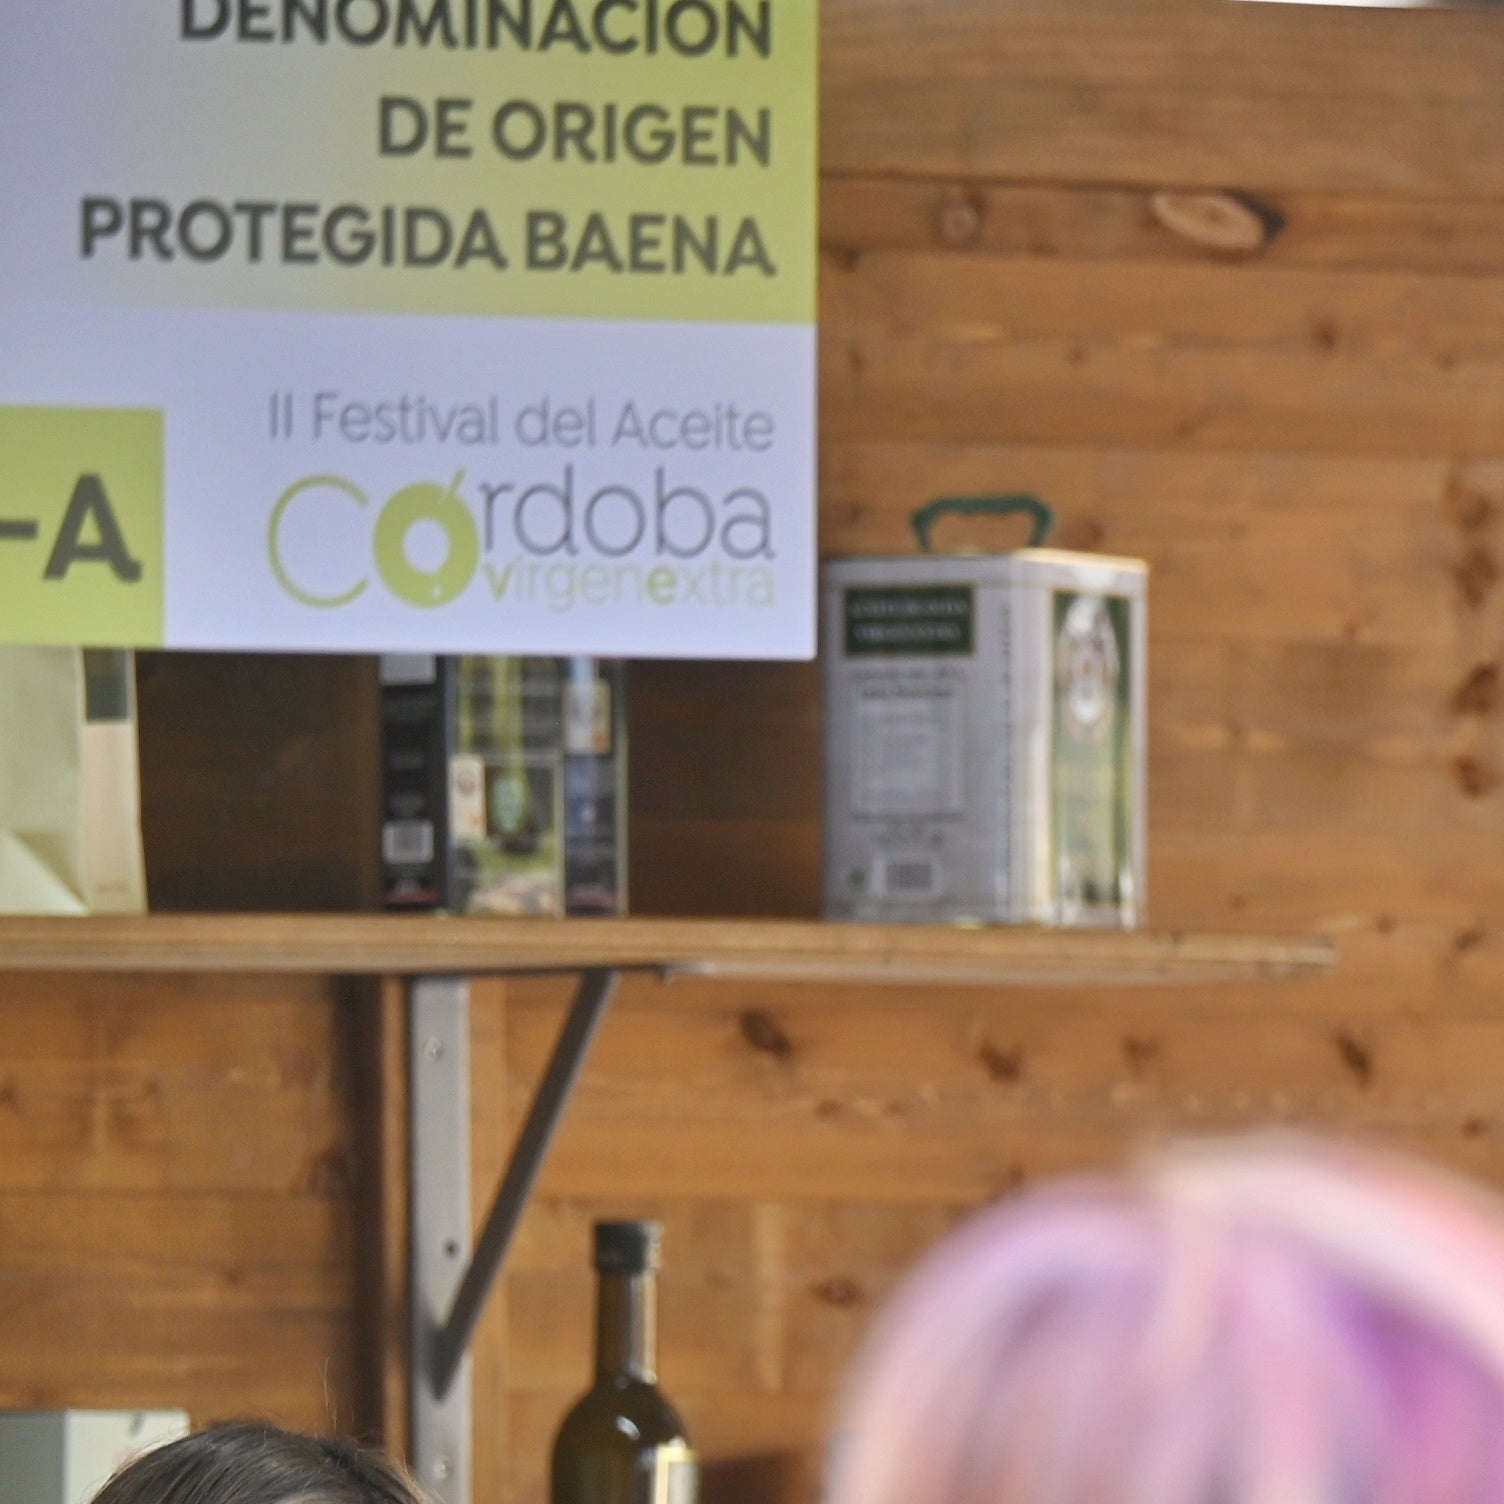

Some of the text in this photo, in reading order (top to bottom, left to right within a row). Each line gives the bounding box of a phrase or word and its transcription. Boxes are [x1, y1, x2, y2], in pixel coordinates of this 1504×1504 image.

[378, 96, 773, 167] DE ORIGEN
[79, 196, 778, 278] PROTEGIDA BAENA
[312, 392, 500, 448] Festival
[514, 396, 596, 450] del
[612, 400, 777, 452] Aceite
[267, 463, 778, 609] Córdoba
[482, 557, 779, 613] virgenextra
